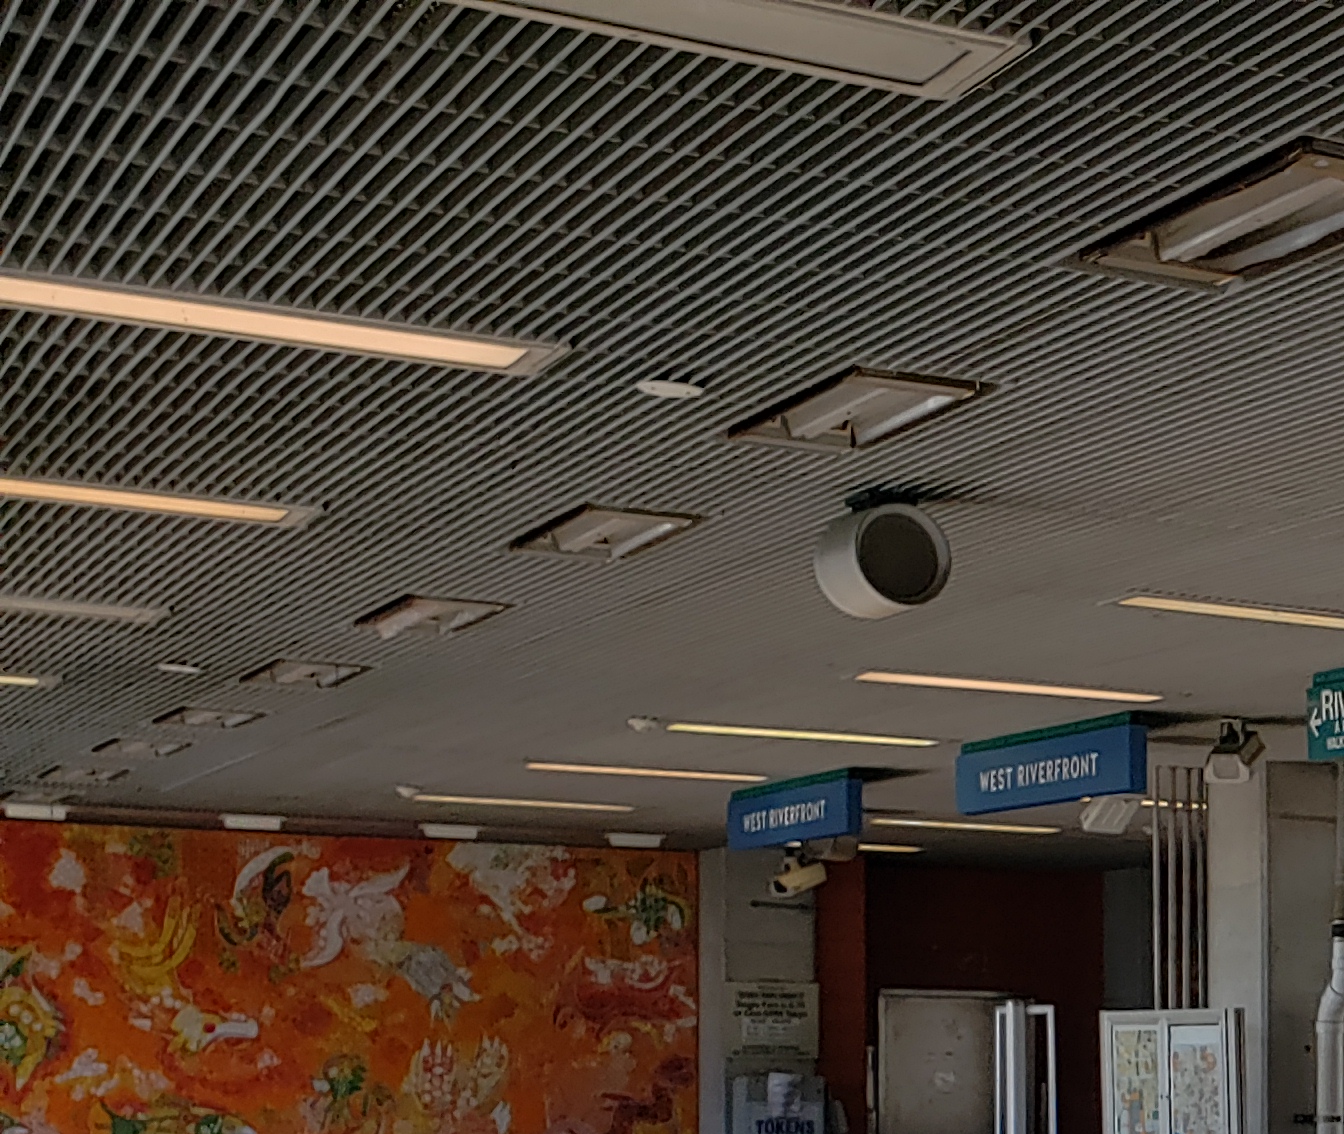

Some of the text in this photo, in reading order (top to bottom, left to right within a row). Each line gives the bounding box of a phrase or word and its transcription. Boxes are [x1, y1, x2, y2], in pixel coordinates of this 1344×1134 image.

[979, 752, 1099, 793] WEST RIVERFRONT
[743, 799, 826, 833] WEST RIVERFRONT
